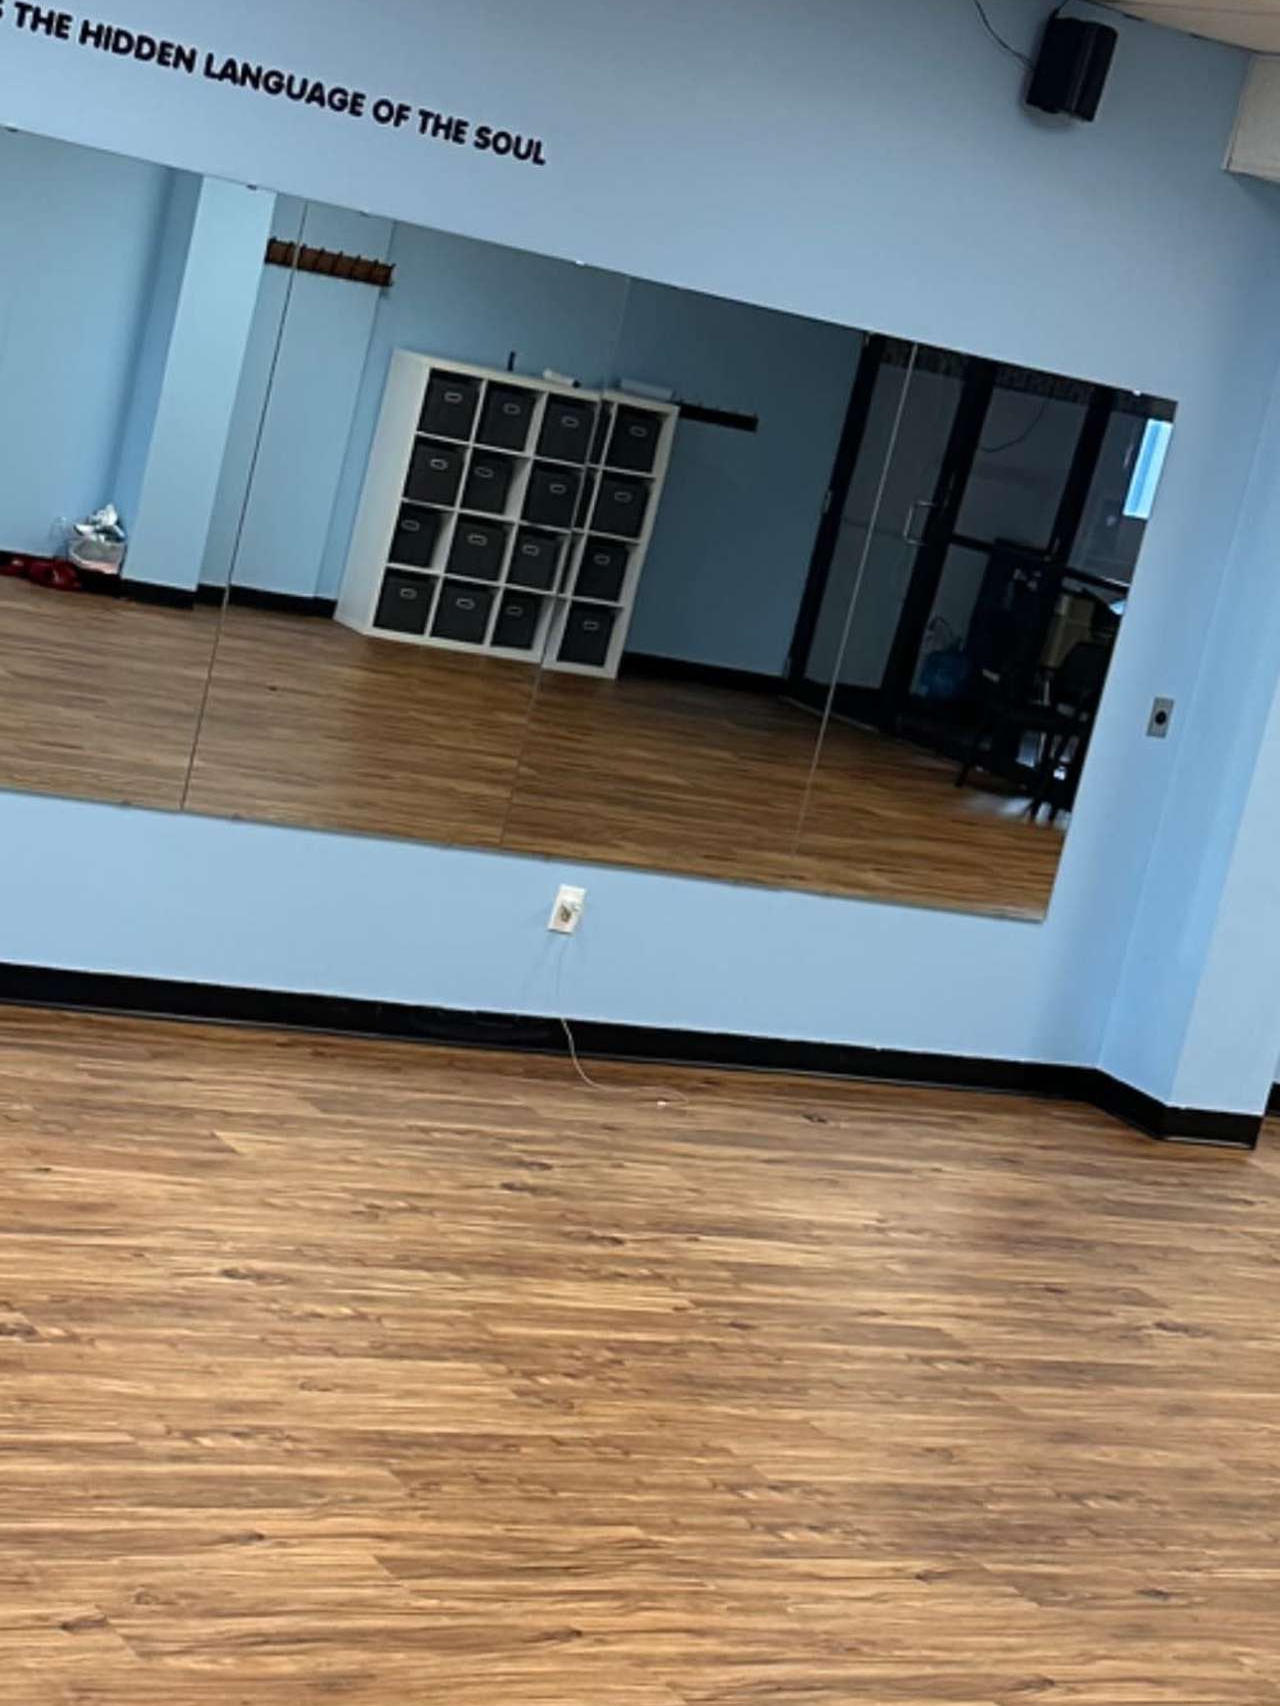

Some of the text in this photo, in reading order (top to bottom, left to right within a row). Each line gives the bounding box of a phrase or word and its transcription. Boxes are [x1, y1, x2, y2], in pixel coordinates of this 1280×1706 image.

[14, 1, 73, 40] THE
[78, 19, 197, 74] HIDDEN
[203, 52, 366, 118] LANGUAGE
[372, 98, 412, 129] OF
[418, 108, 470, 145] THE
[473, 126, 546, 166] SOUL
